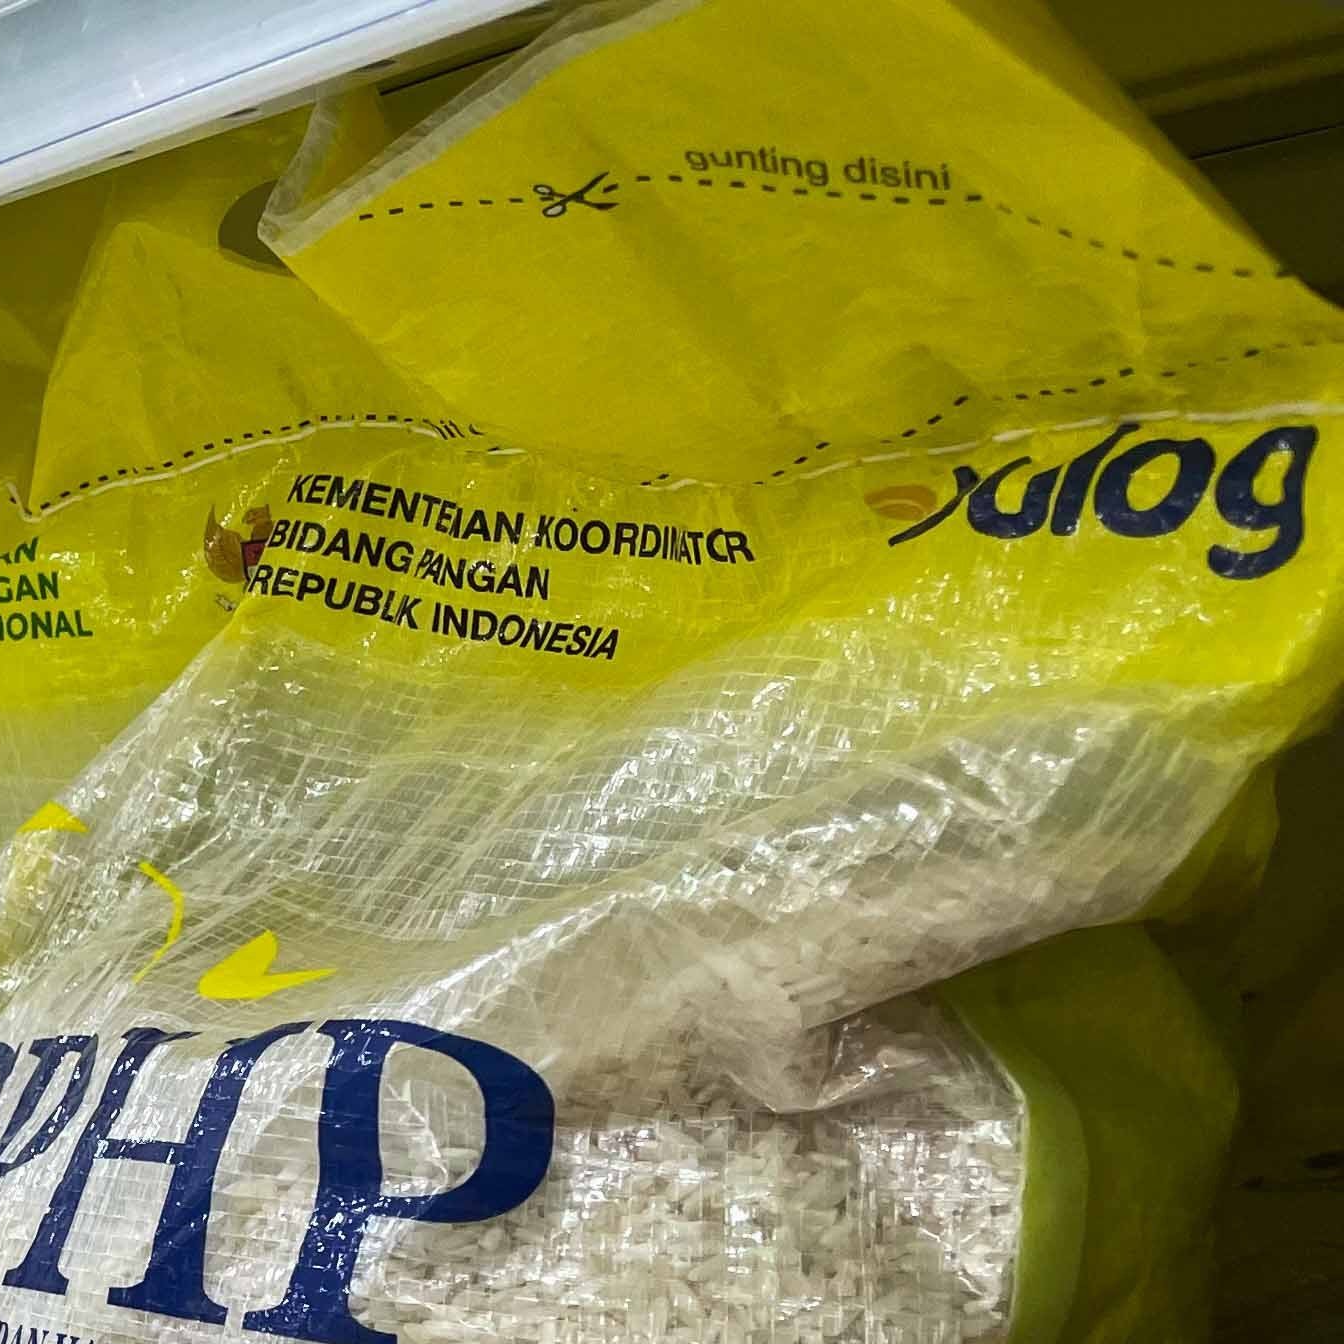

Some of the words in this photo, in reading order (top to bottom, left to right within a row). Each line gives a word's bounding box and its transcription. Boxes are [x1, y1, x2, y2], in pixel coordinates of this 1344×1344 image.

[684, 146, 830, 187] gunting
[843, 155, 952, 191] disini
[266, 519, 414, 574] BIDANG
[414, 548, 550, 601] PANGAN
[431, 601, 620, 661] INDONESIA
